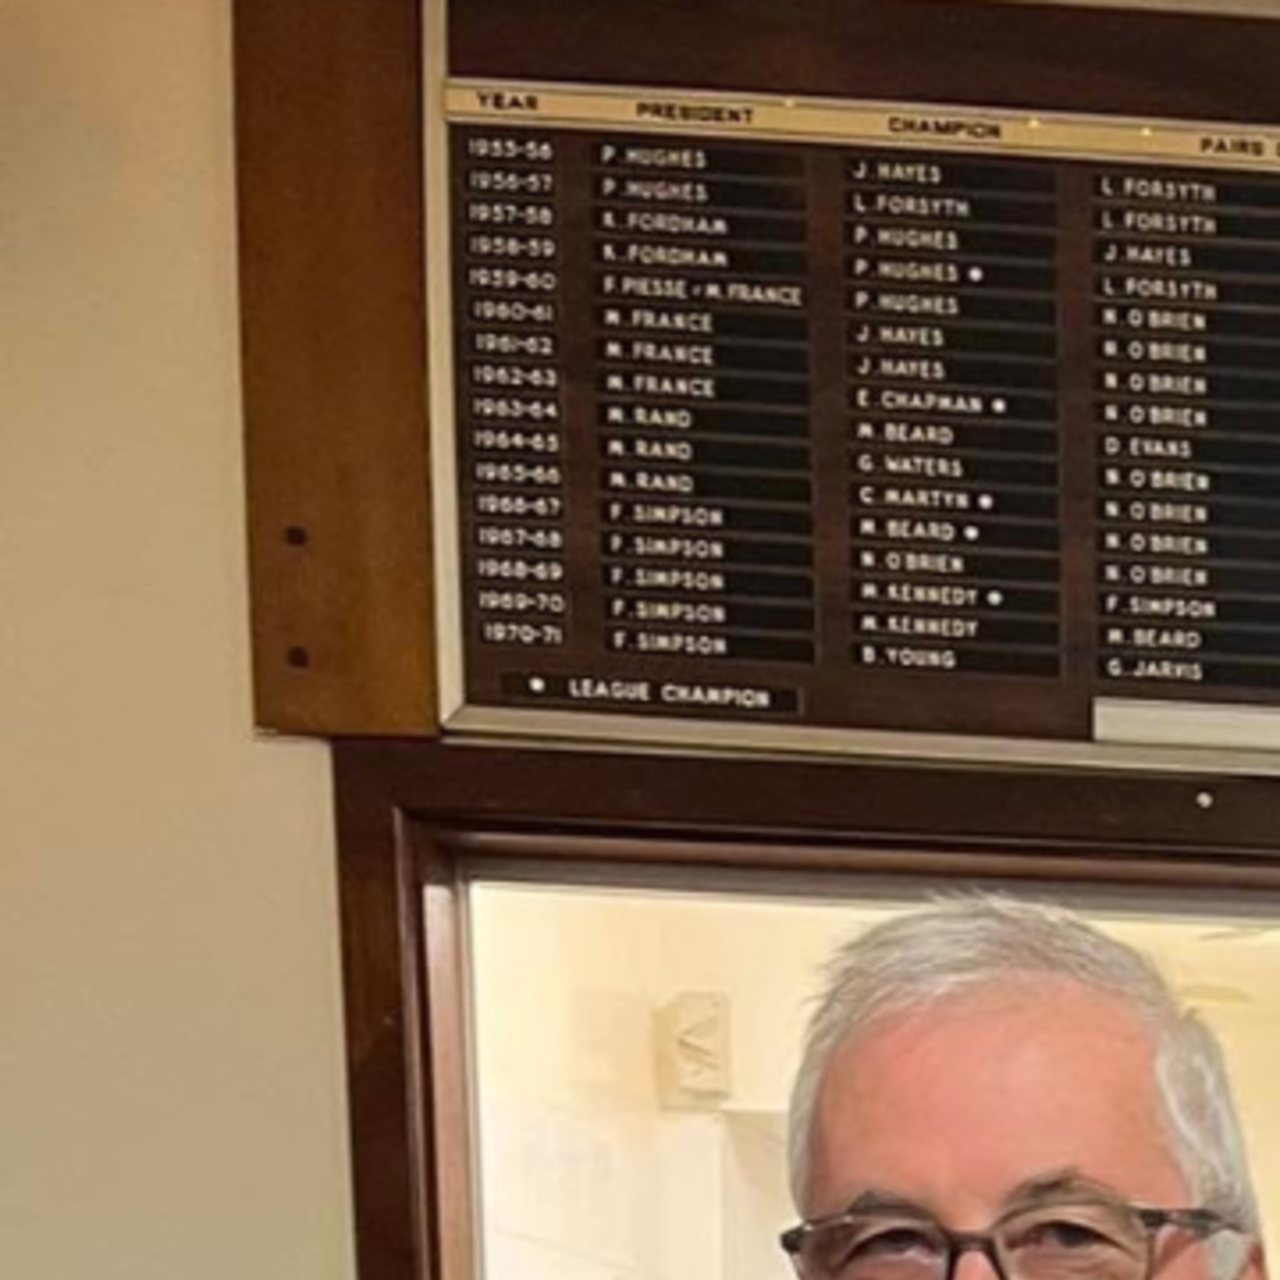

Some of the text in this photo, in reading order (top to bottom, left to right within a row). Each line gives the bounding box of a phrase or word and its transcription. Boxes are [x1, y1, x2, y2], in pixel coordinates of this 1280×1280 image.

[478, 93, 538, 111] YEAR
[636, 102, 753, 124] PRESIDENT
[1200, 137, 1264, 156] PAIRS
[570, 679, 769, 707] LEAGUE CHAMPION
